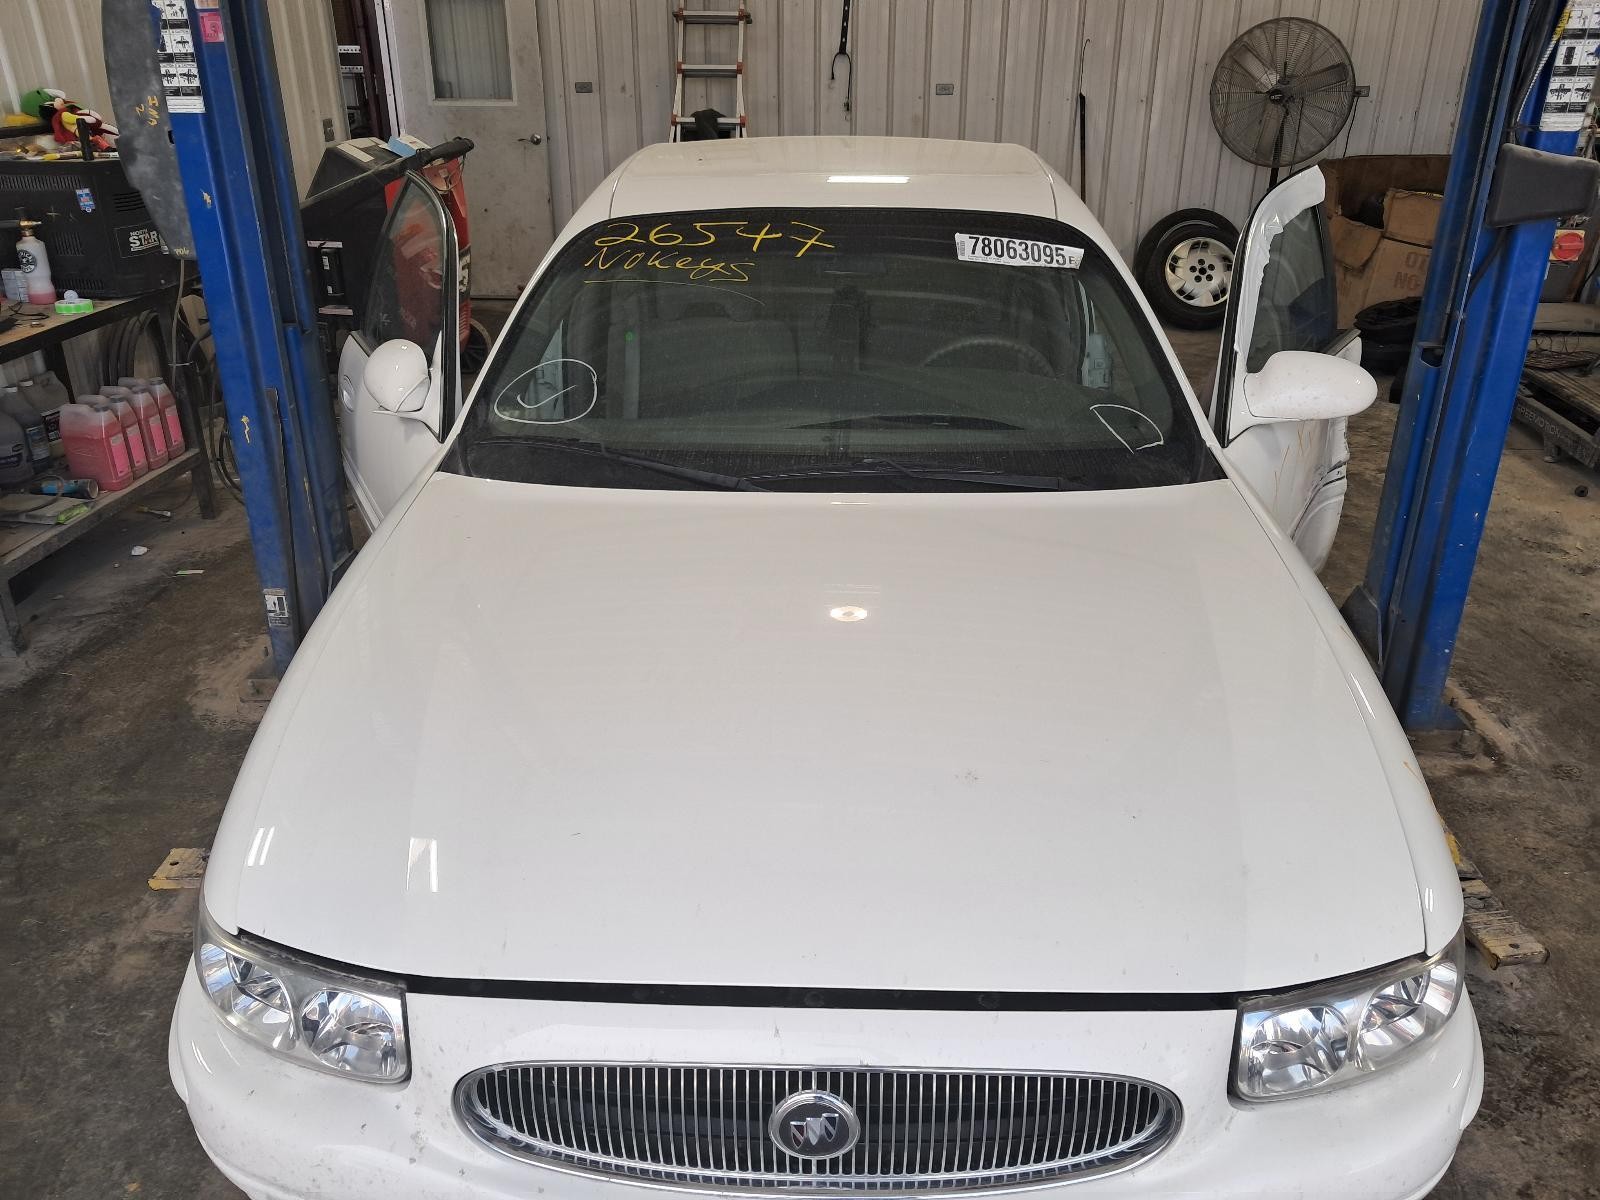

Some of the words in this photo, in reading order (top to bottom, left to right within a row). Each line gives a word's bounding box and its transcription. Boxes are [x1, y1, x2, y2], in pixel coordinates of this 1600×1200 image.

[128, 230, 159, 249] STAR
[594, 220, 836, 258] 26547
[968, 235, 1067, 267] 78063095
